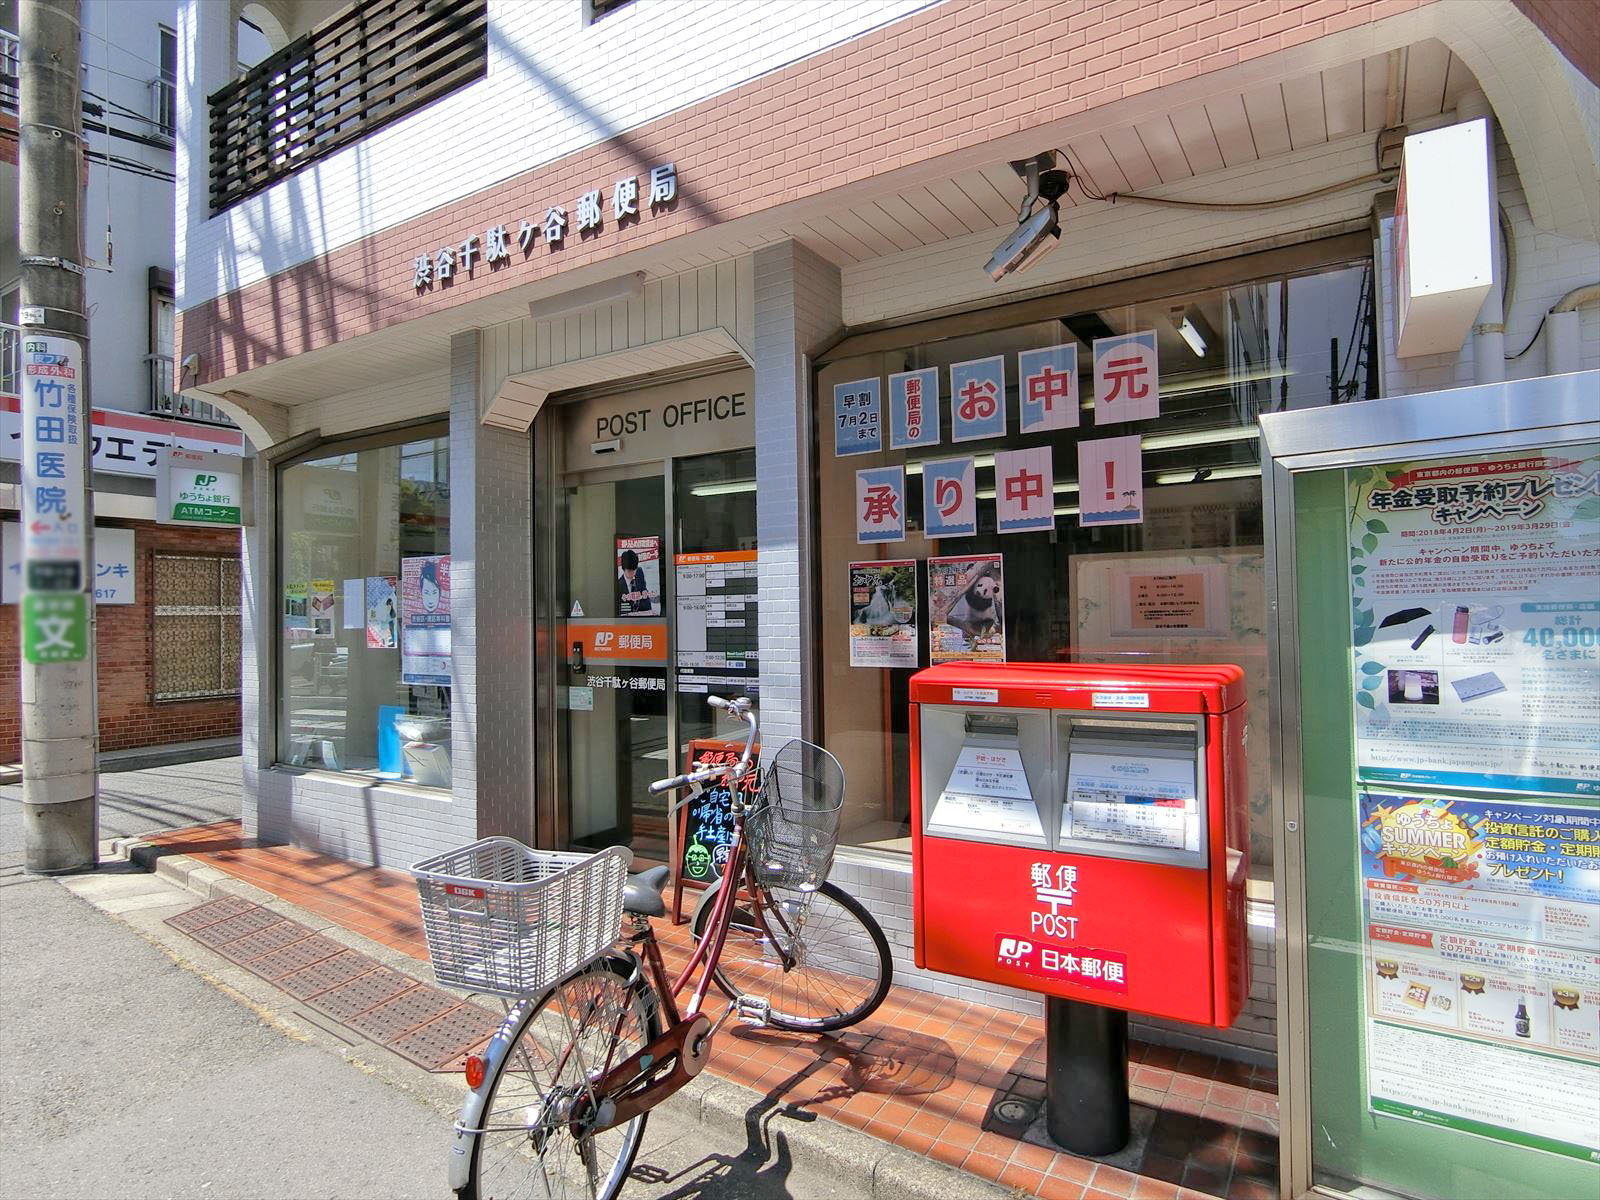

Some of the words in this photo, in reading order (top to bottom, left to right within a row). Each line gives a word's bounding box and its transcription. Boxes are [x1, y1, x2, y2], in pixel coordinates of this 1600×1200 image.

[28, 366, 75, 378] 形成外科
[843, 391, 871, 410] 早割
[905, 378, 921, 439] 郵便局の
[597, 409, 651, 438] POST
[663, 392, 746, 428] OFFICE
[838, 411, 878, 428] 7月2日
[857, 427, 878, 440] まで
[34, 379, 67, 514] 竹田医院
[180, 491, 231, 504] ゆうちょ銀行
[181, 506, 236, 517] ATMコーナー
[1436, 501, 1541, 522] キャンペーン
[618, 634, 653, 650] 郵便局
[1396, 813, 1454, 830] ゆうちょ
[1382, 826, 1466, 850] SUMMER
[1382, 842, 1468, 861] キャンペーン
[1031, 861, 1077, 893] 郵便
[1031, 911, 1078, 940] POST
[997, 956, 1030, 968] POST
[1041, 949, 1124, 984] 日本郵便
